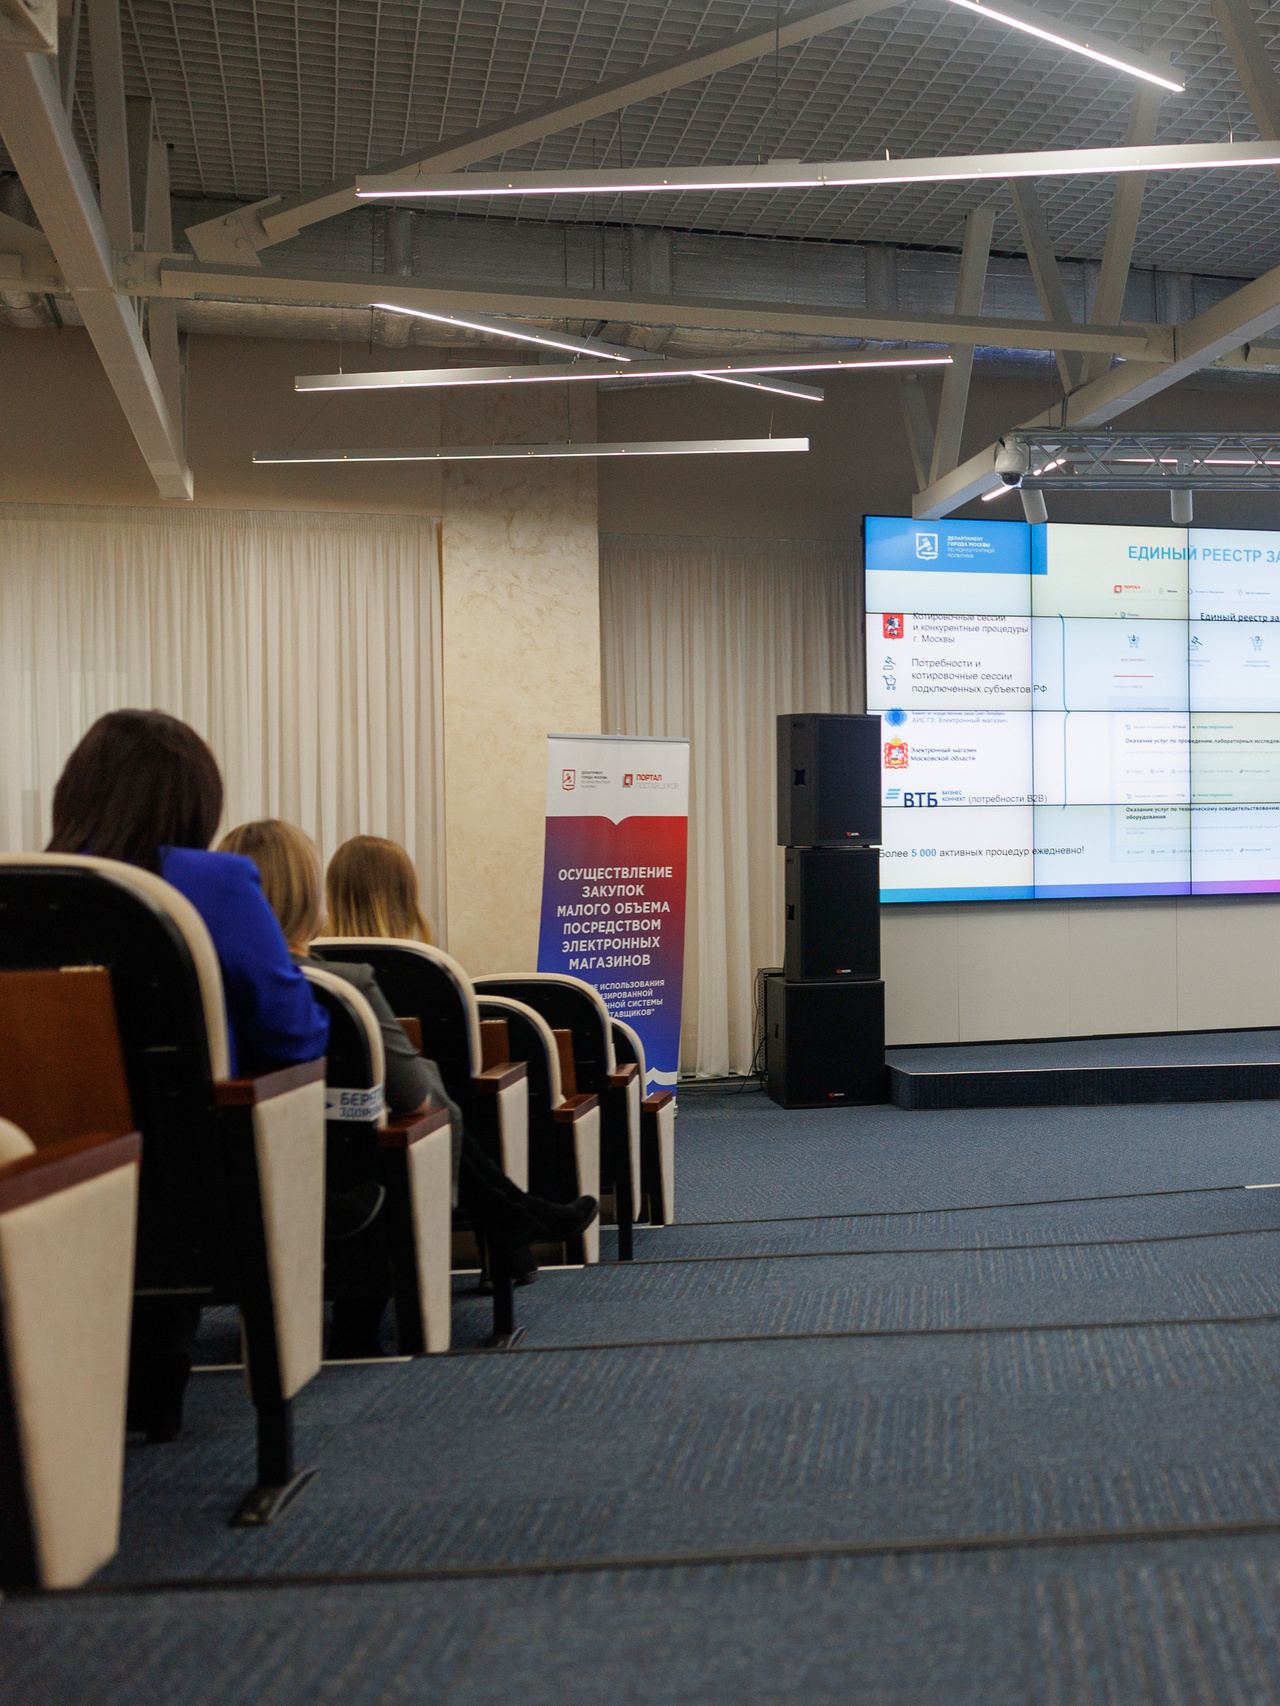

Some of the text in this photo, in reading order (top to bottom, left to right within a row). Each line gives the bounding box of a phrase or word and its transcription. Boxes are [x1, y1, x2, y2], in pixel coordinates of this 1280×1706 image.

[1128, 545, 1197, 561] ЕДИНЫЙ
[1202, 548, 1262, 563] РЕЕСТР
[913, 613, 1006, 622] Котировочные сессии
[1200, 612, 1235, 622] Единый
[1238, 614, 1268, 623] реестр
[921, 625, 980, 634] конкурентные
[982, 626, 1029, 634] процедуры
[922, 635, 955, 643] Москвы
[912, 659, 973, 670] Потребности
[912, 672, 978, 682] котировочные
[912, 685, 1048, 695] подключенных субъектов РФ
[903, 792, 938, 807] ВТБ
[968, 795, 1025, 804] (потребности
[879, 846, 1085, 858] Более 5 000 активных процедур ежедневно!
[558, 866, 673, 881] ОСУЩЕСТВЛЕНИЕ
[581, 884, 645, 898] ЗАКУПОК
[557, 901, 670, 917] МАЛОГО ОБЪЕМА
[563, 919, 661, 934] ПОСРЕДСТВОМ
[562, 936, 660, 952] ЭЛЕКТРОННЫХ
[569, 954, 651, 970] МАГАЗИНОВ
[600, 980, 665, 990] ИСПОЛЬЗОВАНИЯ
[627, 999, 663, 1007] СИСТЕМЫ
